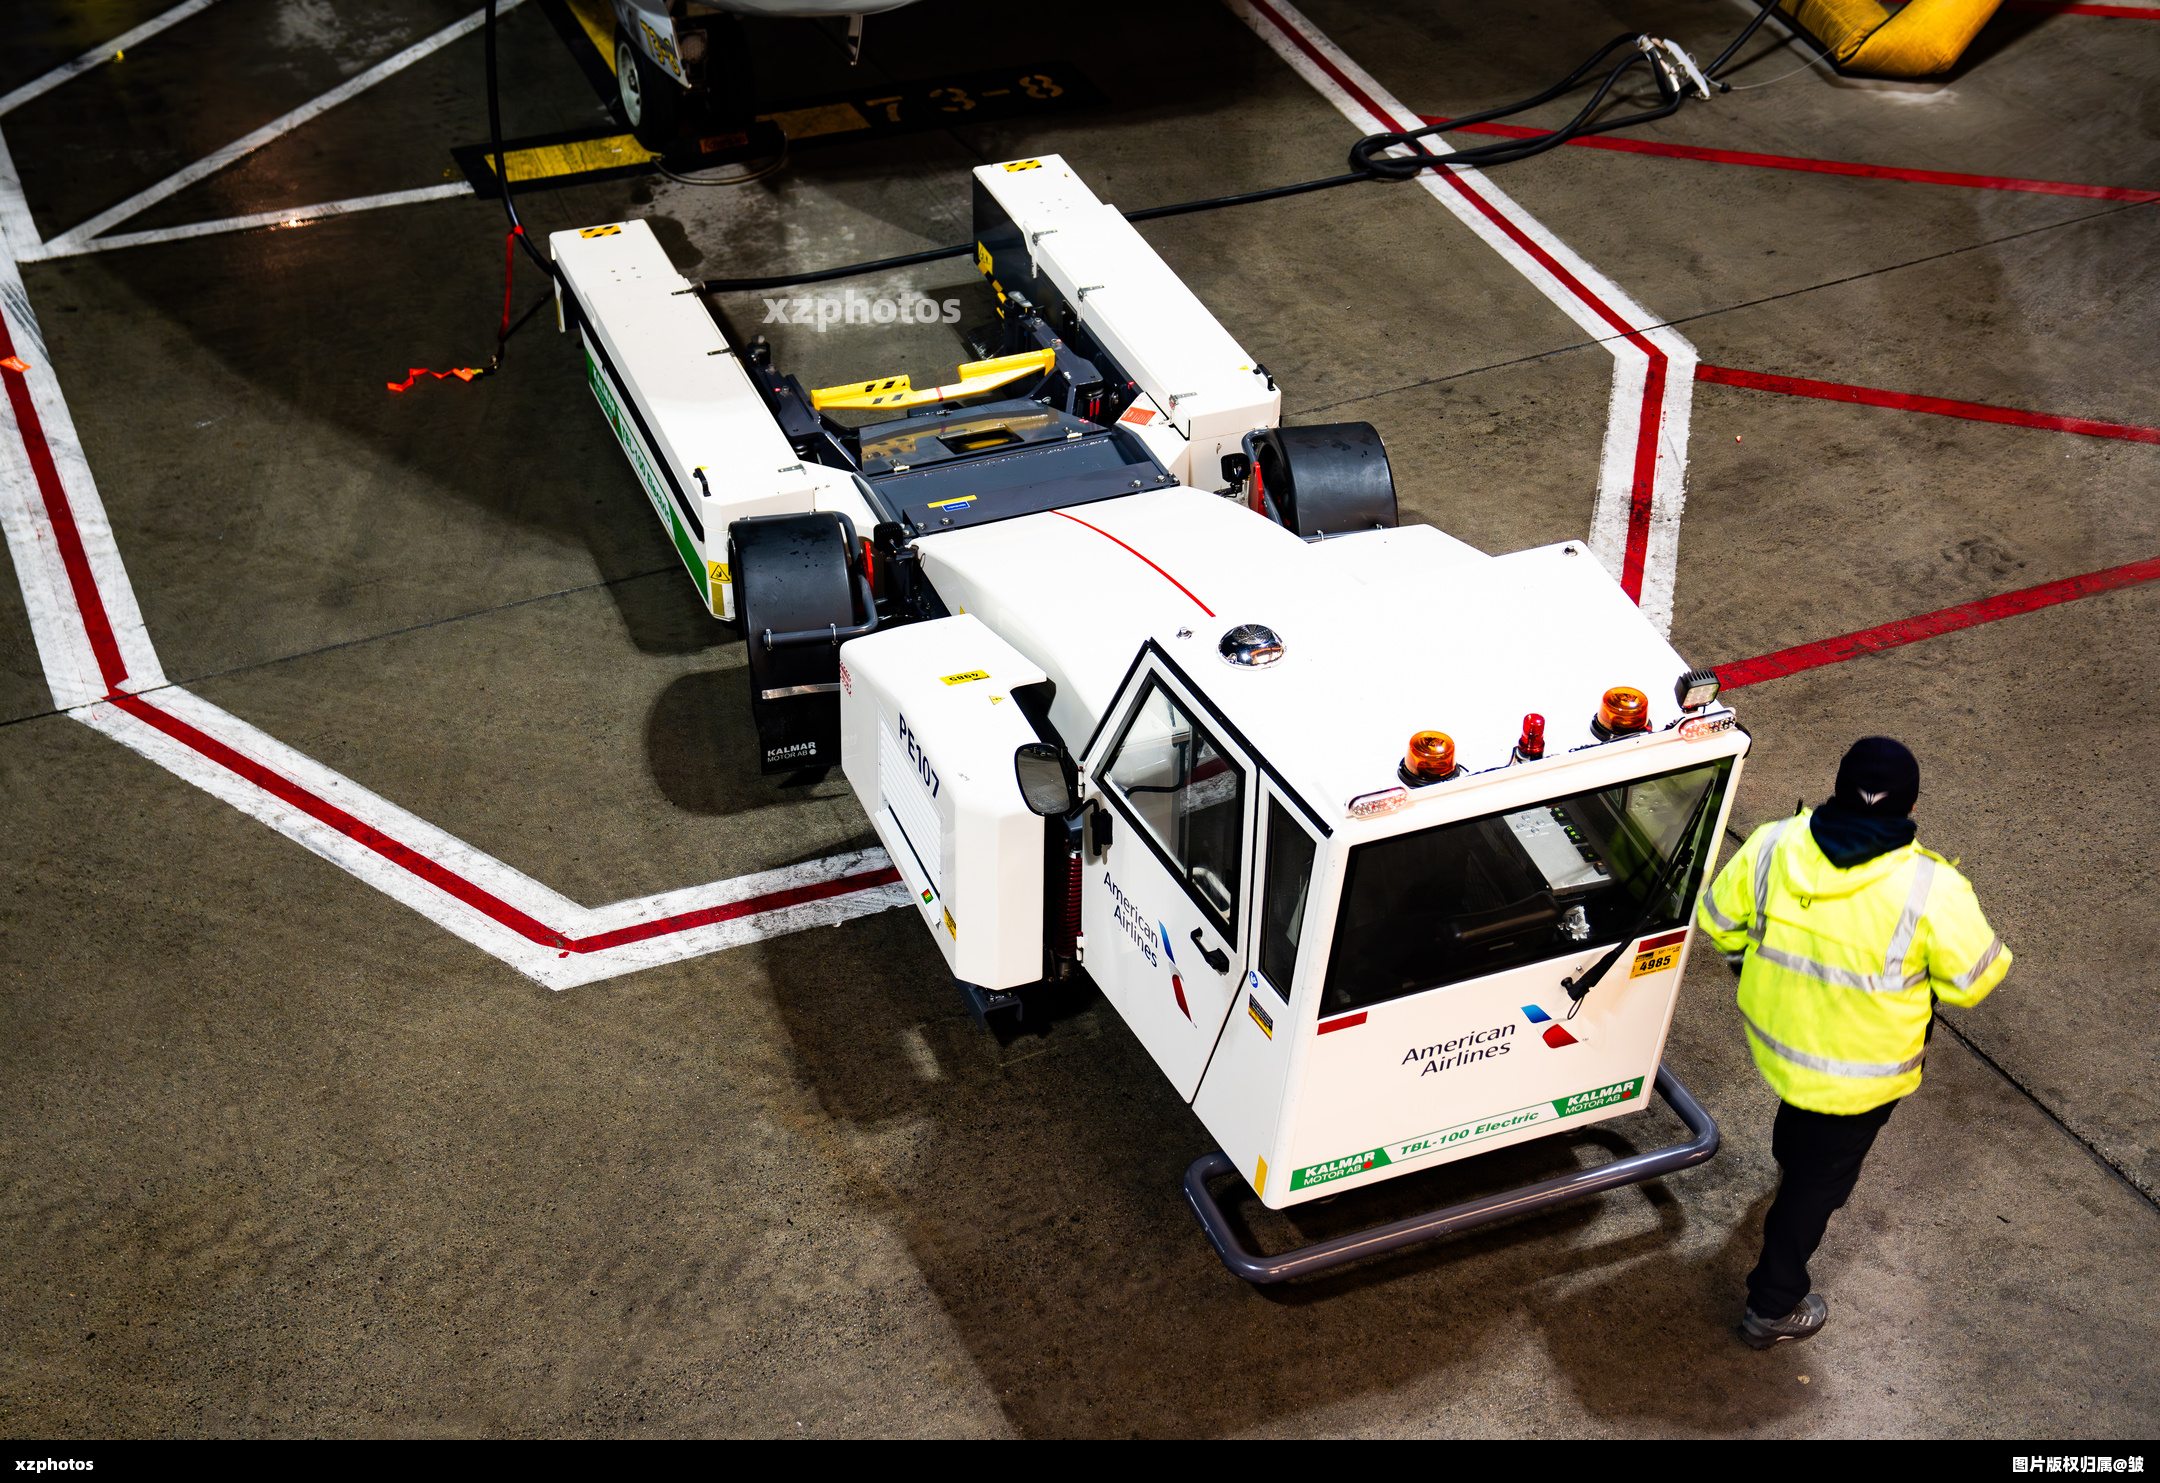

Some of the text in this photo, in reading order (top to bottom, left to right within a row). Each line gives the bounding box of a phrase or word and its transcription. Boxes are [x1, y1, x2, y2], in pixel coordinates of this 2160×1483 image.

[767, 741, 817, 757] KALMAR
[767, 749, 808, 763] MOTOR AB
[899, 712, 939, 798] PE107
[1103, 871, 1159, 949] American
[1113, 904, 1158, 968] Airlines
[1639, 955, 1672, 971] 4985
[1401, 1024, 1516, 1065] American
[1420, 1042, 1512, 1077] Airlines
[1565, 1094, 1621, 1115] MOTOR AB
[1567, 1081, 1635, 1106] KALMAR
[1401, 1112, 1539, 1155] TBL-100 Electric
[1303, 1164, 1362, 1186] MOTOR AB
[1305, 1151, 1375, 1178] KALMAR
